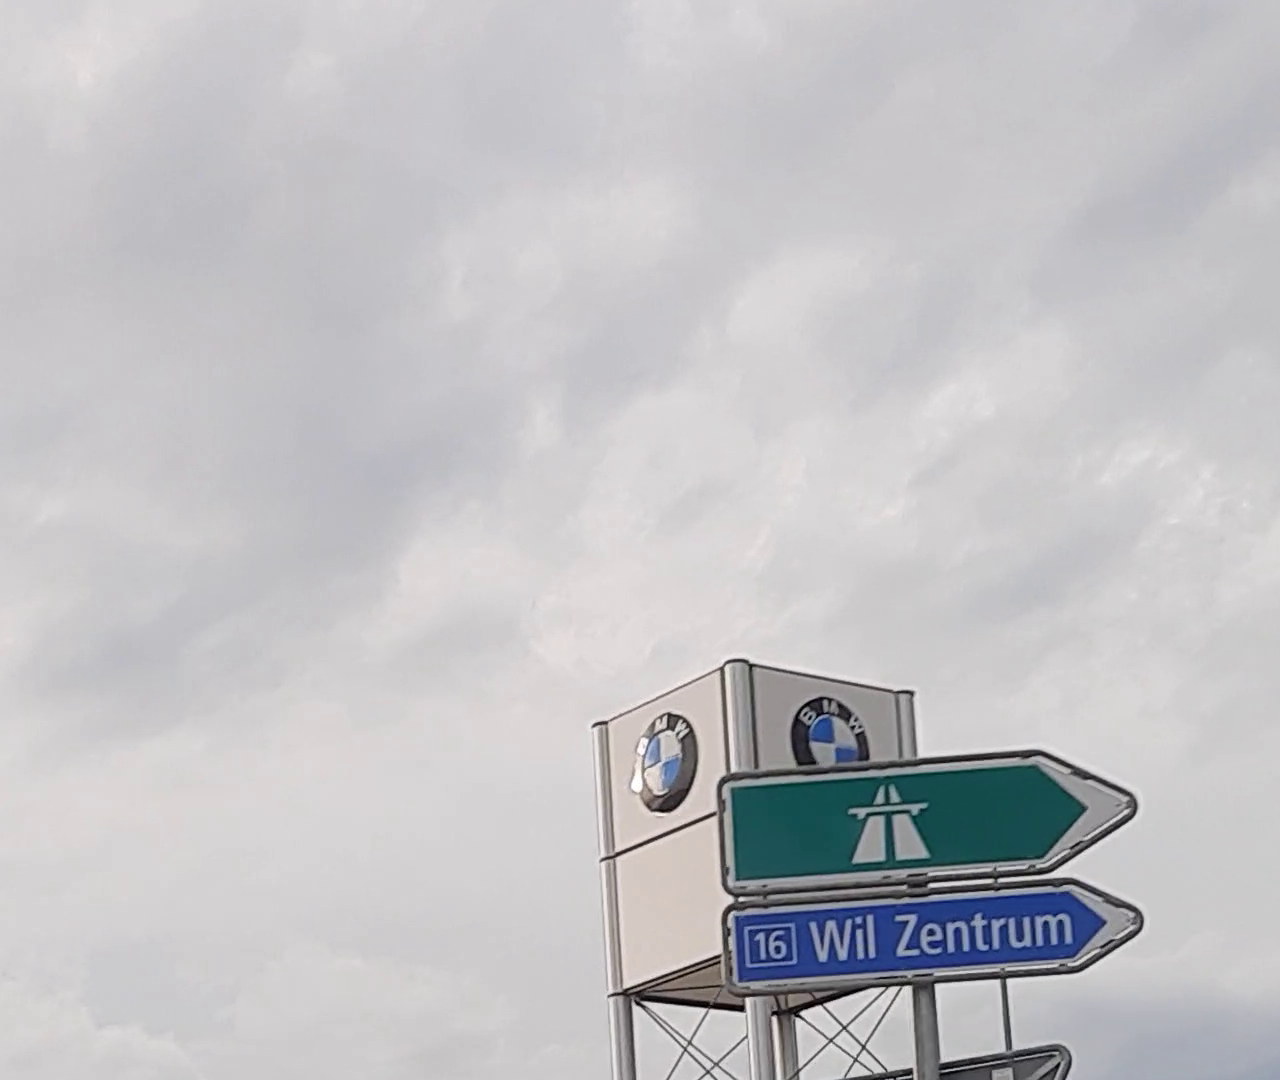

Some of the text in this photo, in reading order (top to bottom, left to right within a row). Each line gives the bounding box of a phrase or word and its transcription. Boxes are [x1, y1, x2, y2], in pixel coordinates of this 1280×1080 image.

[800, 700, 865, 734] BMW
[753, 911, 1074, 963] 16 Wil Zentrum
